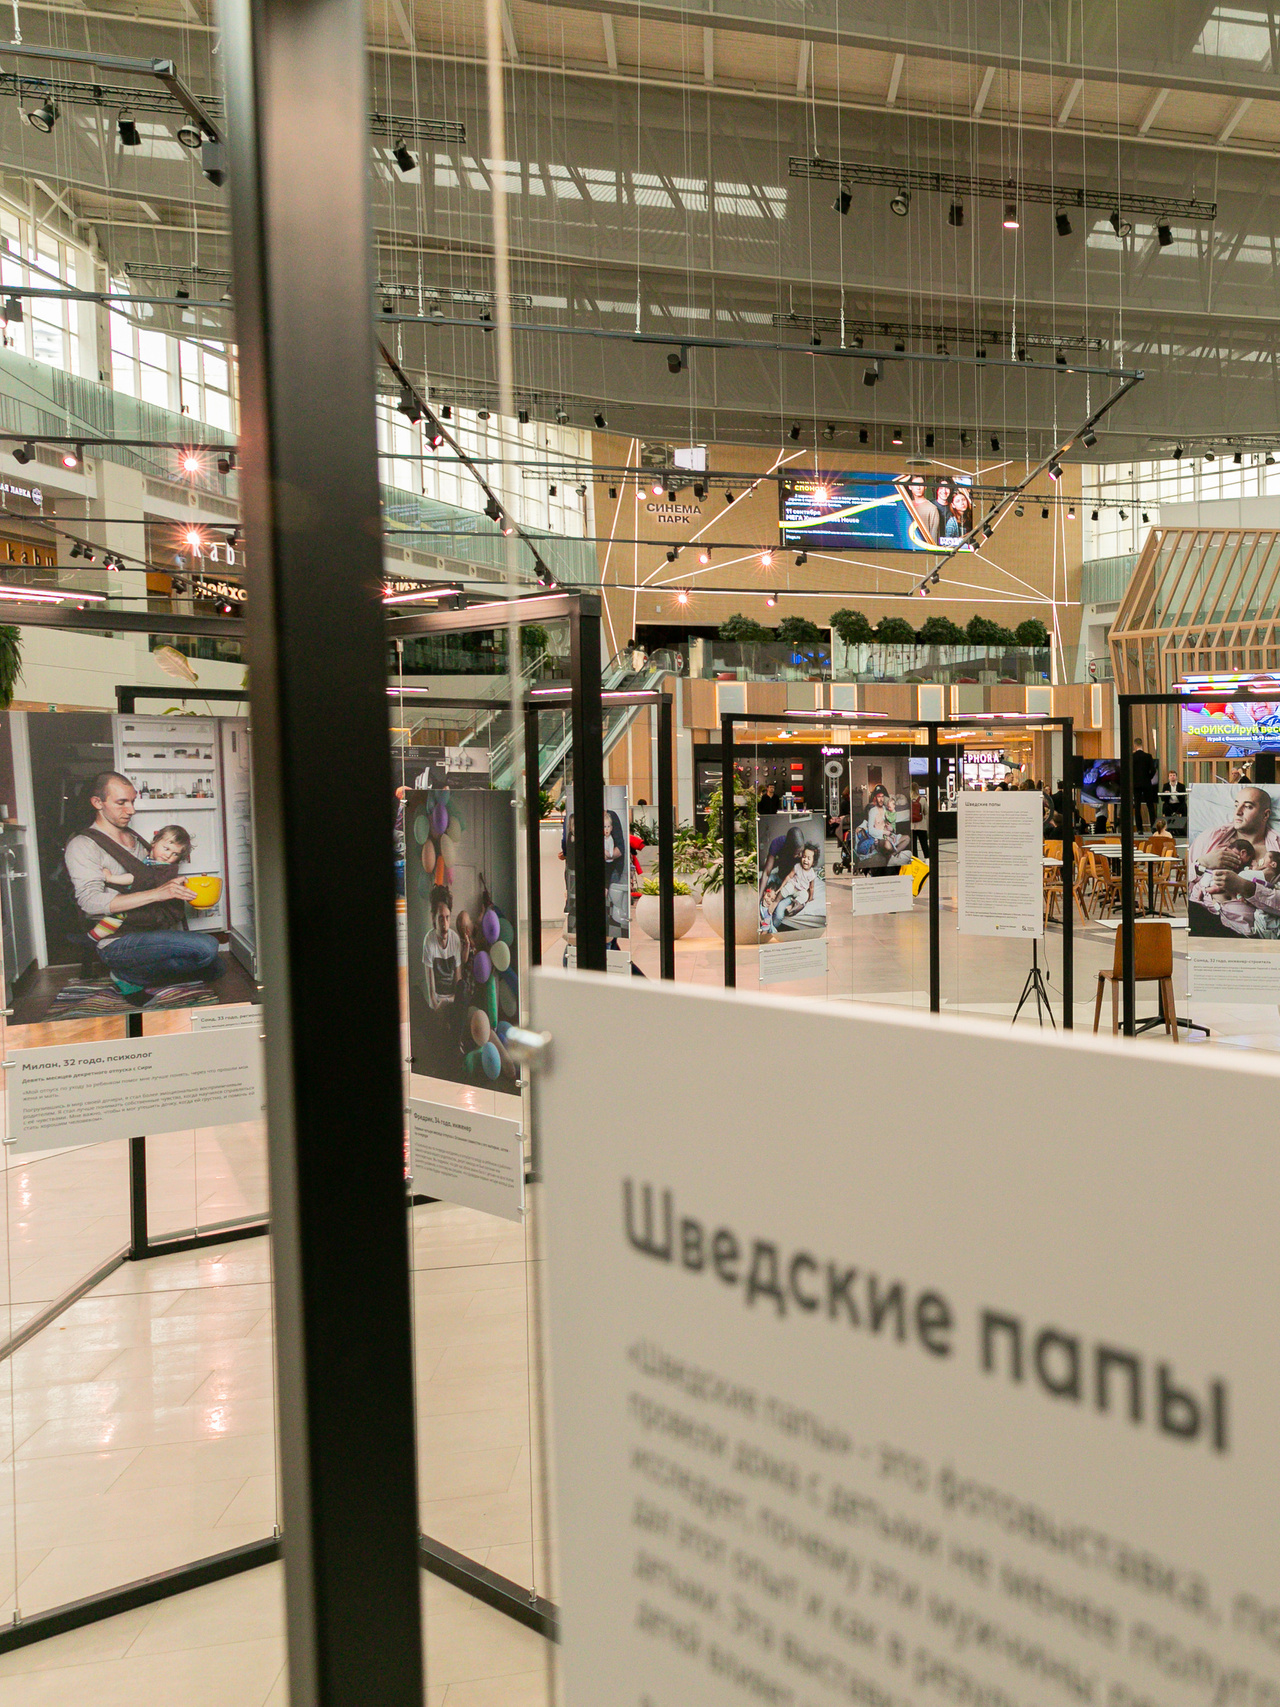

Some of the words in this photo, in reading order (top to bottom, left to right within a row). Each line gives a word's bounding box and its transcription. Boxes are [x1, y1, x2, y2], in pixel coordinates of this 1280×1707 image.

[646, 503, 702, 514] СИНЕМА
[658, 515, 690, 524] ПАРК
[821, 746, 844, 756] dyson
[22, 1063, 61, 1071] Милан,
[63, 1059, 75, 1067] 32
[78, 1057, 105, 1065] года,
[106, 1052, 153, 1062] психолог
[73, 1070, 107, 1079] декретного
[414, 1112, 434, 1123] Фредрик,
[440, 1119, 452, 1127] года,
[452, 1123, 472, 1133] инженер
[622, 1176, 954, 1359] Шведские
[976, 1304, 1228, 1455] папы
[938, 1462, 1222, 1629] фотовыставка,
